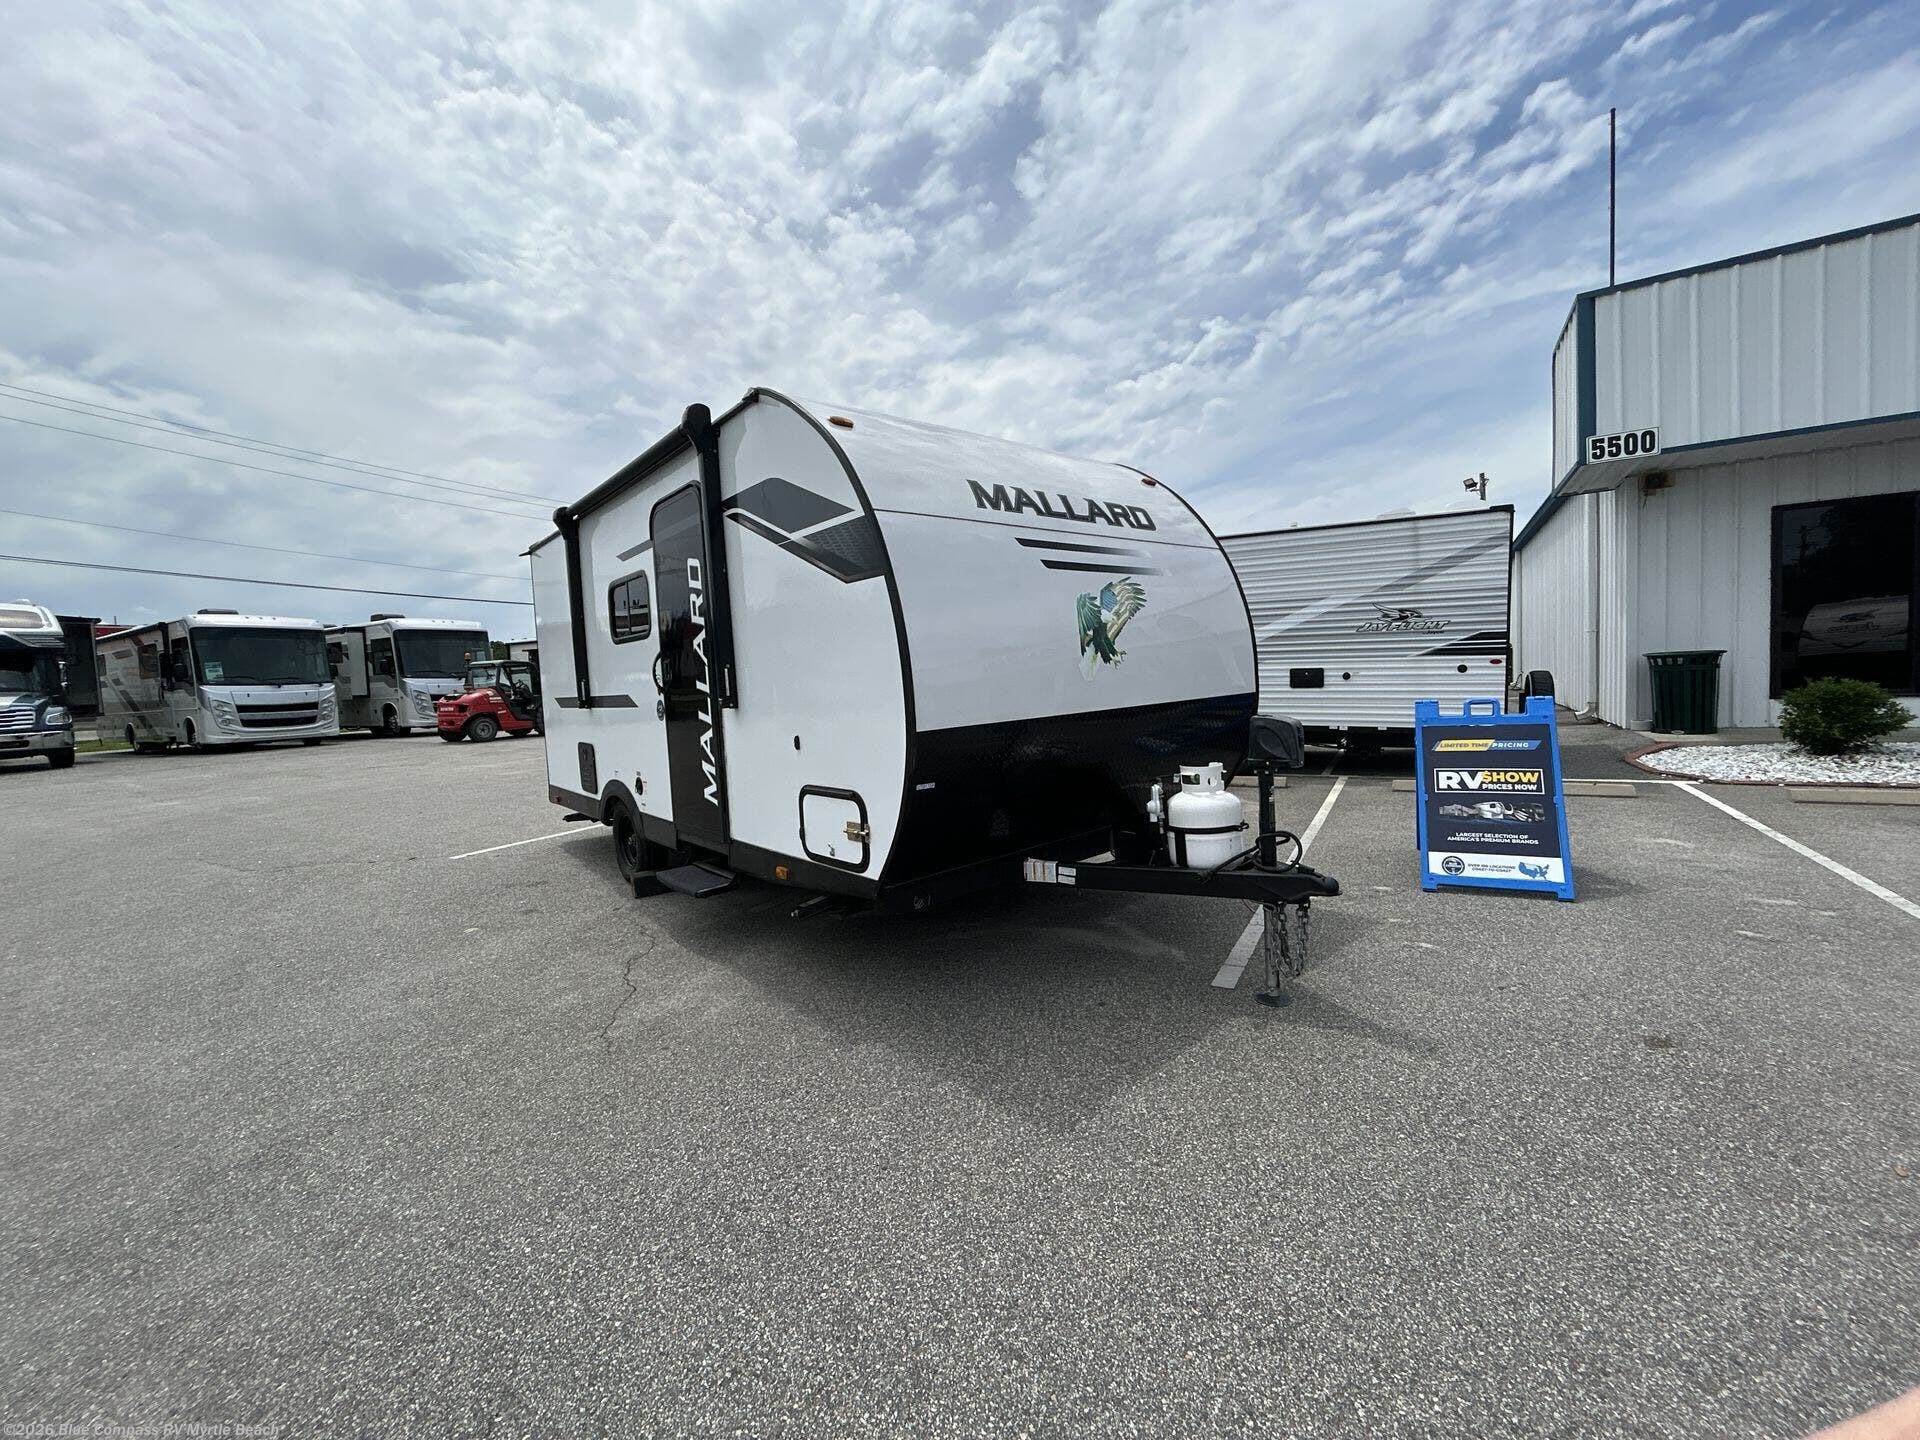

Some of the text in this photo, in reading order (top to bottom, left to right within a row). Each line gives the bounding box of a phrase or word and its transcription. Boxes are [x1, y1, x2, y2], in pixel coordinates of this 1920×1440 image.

[1591, 430, 1656, 460] 5500
[966, 479, 1156, 531] MALLARD
[1356, 620, 1451, 632] JAY FLIGHT
[687, 558, 718, 806] MALLARD
[1438, 771, 1482, 789] RV
